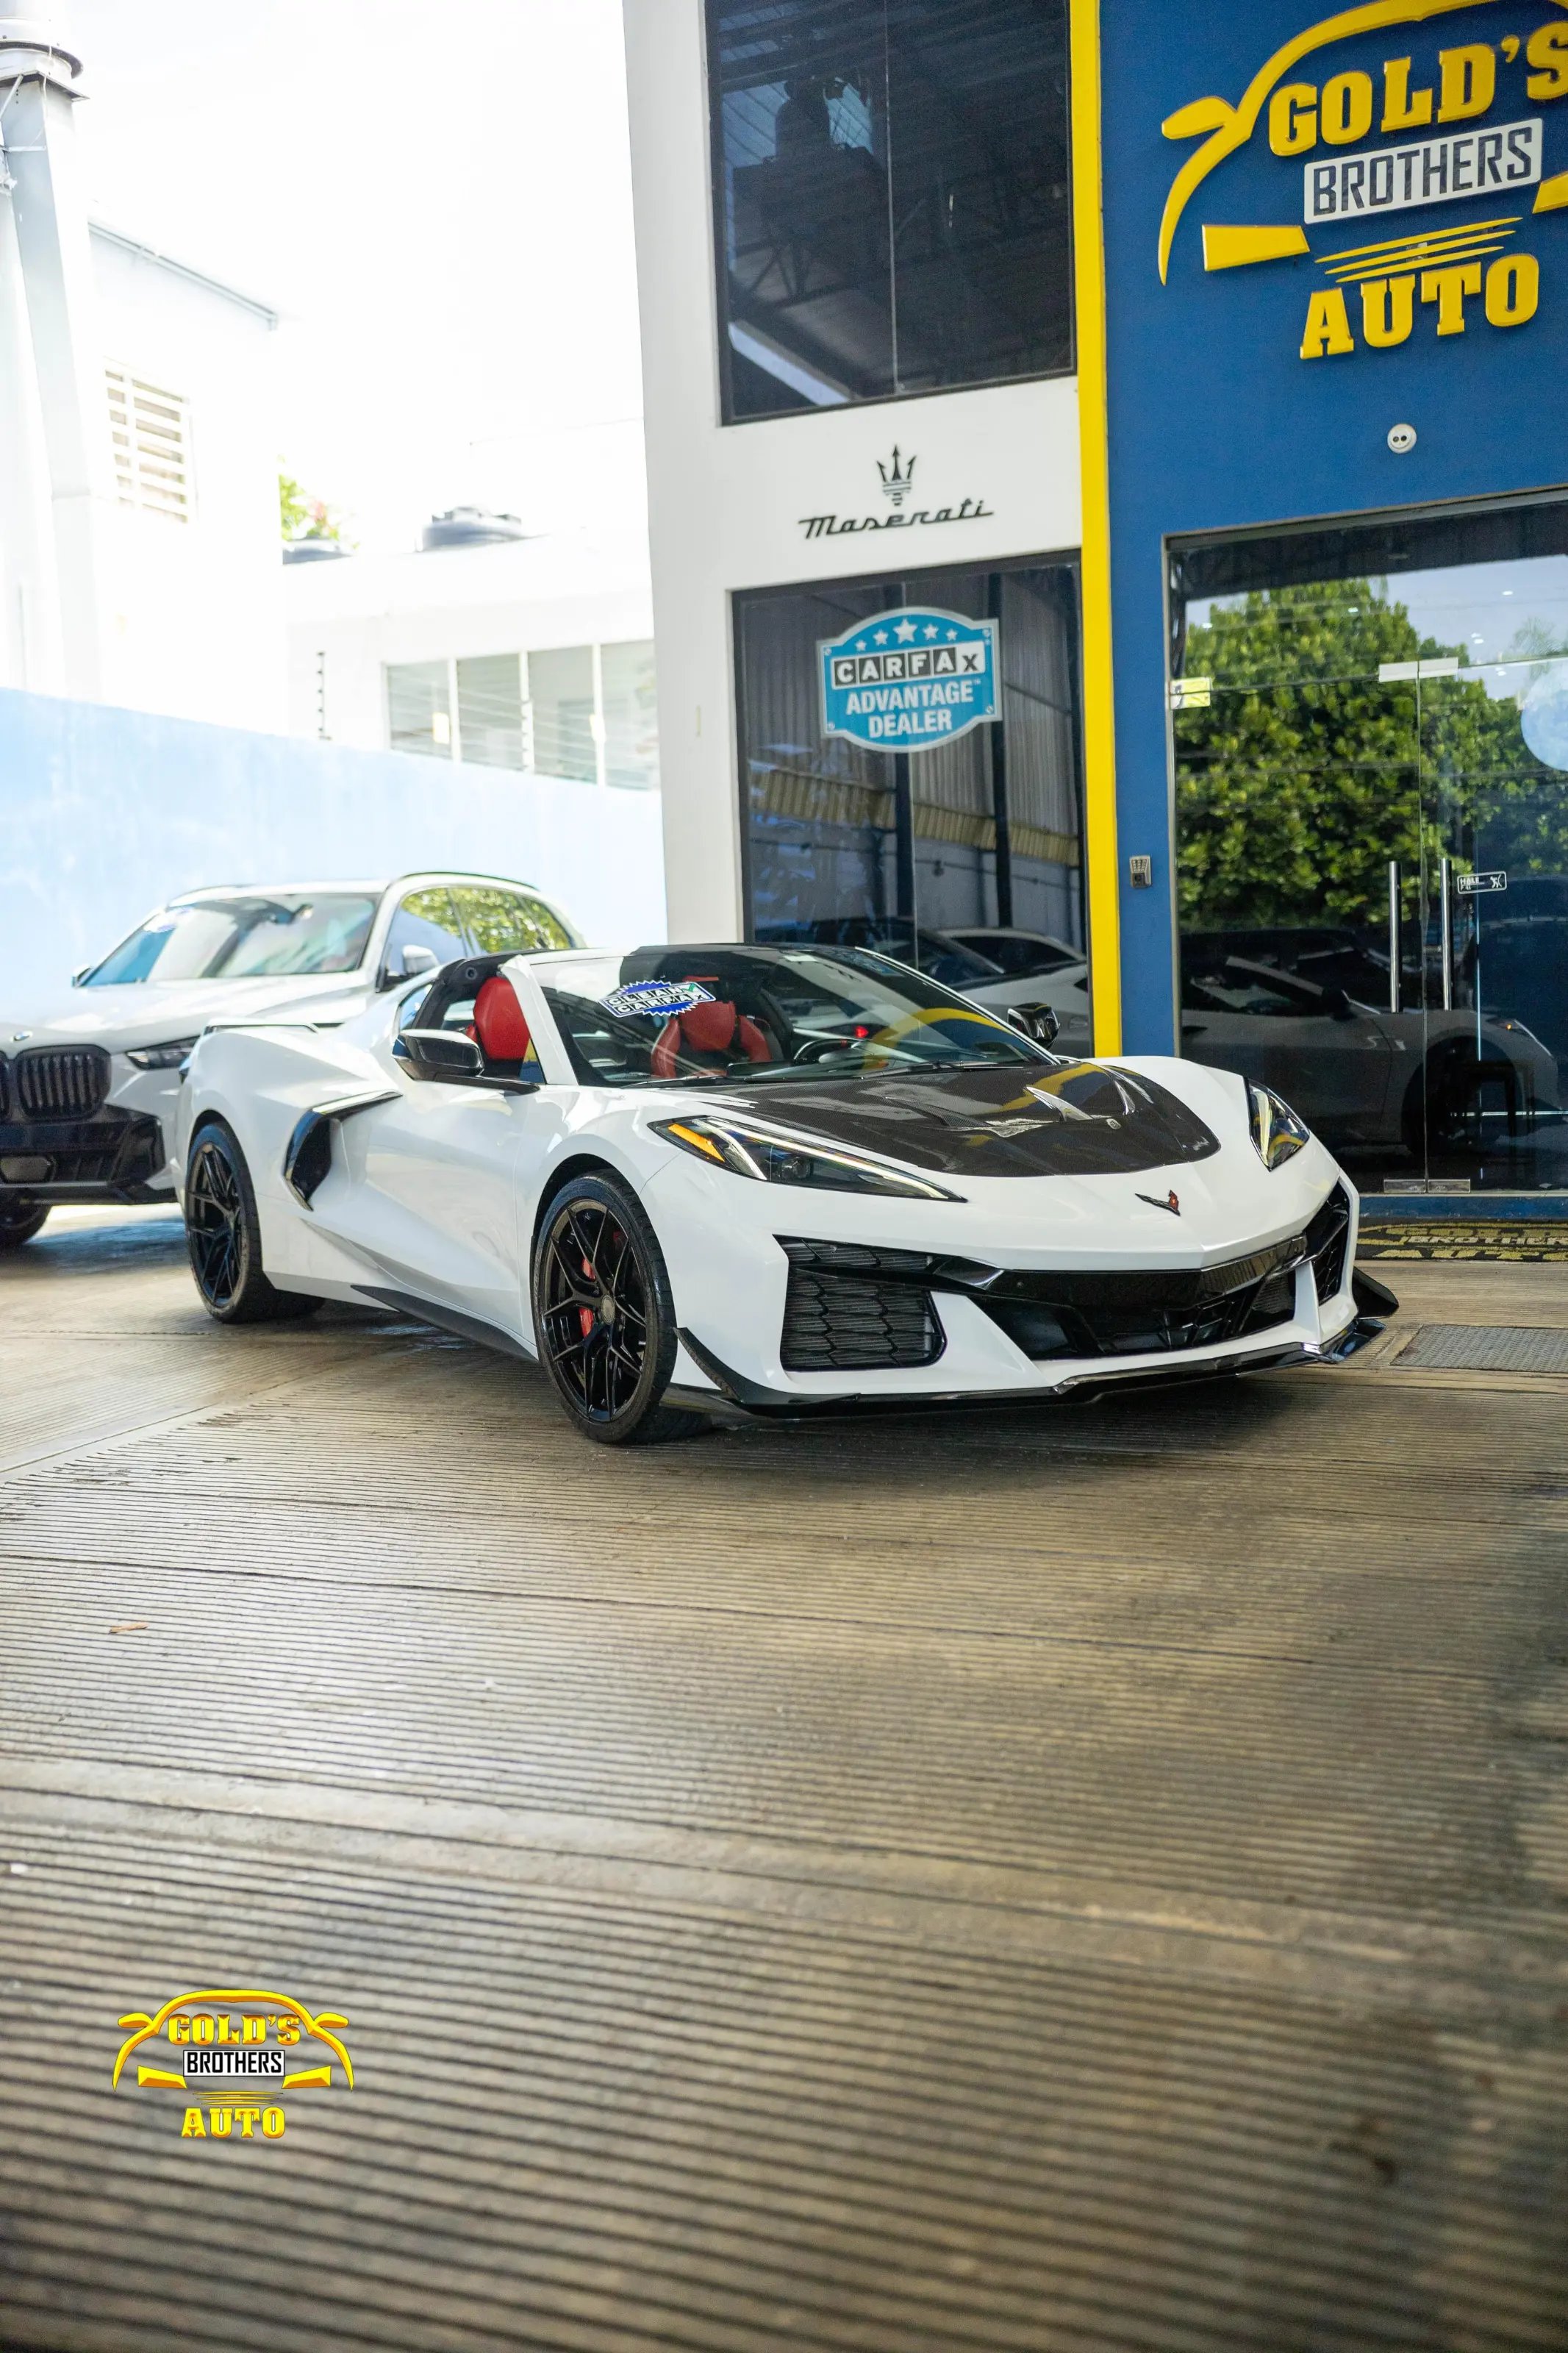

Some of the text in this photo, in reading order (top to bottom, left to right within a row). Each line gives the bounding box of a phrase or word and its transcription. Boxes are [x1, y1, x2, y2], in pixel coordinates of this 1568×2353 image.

[1269, 21, 1568, 157] GOLD'S
[1313, 126, 1533, 216] BROTHERS
[1300, 253, 1539, 360] AUTO
[798, 498, 994, 539] Maserati
[836, 650, 978, 683] CARFAX
[868, 708, 952, 738] DEALER
[608, 987, 683, 1005] CLEAN
[617, 993, 706, 1013] CARFAX
